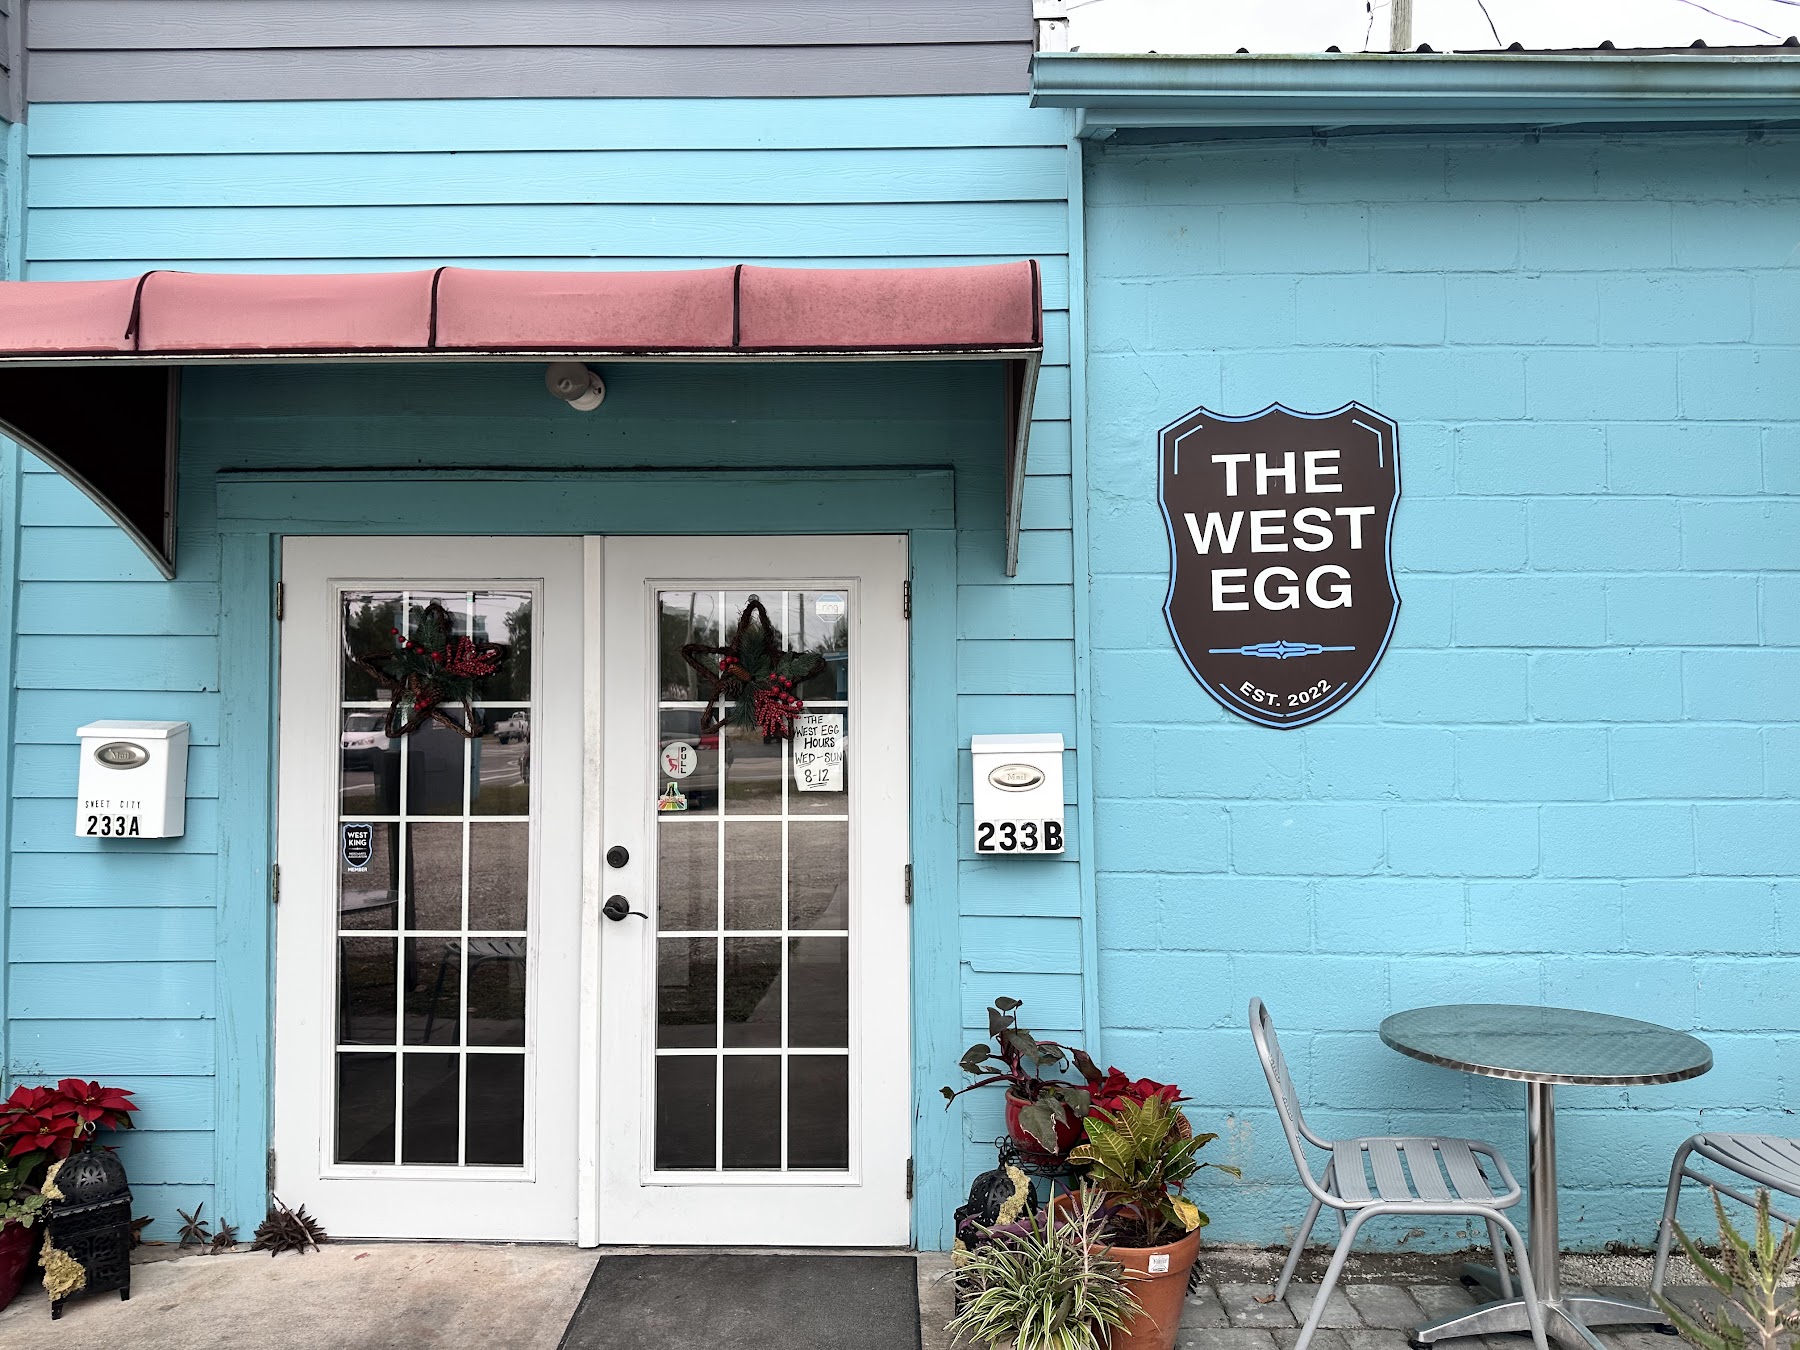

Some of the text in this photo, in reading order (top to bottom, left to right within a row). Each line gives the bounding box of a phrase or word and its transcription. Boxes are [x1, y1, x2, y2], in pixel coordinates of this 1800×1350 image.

[1211, 450, 1343, 496] THE
[1183, 506, 1376, 555] WEST
[1211, 564, 1353, 612] EGG
[1239, 679, 1332, 707] EST. 2022
[803, 715, 824, 724] THE
[794, 724, 840, 738] WEST EGG
[804, 737, 835, 749] HOURS
[111, 750, 130, 759] Mail
[804, 768, 830, 783] 8-12
[1007, 773, 1027, 781] Mail
[120, 800, 140, 809] CITY
[86, 815, 140, 836] 233A
[978, 821, 1063, 851] 233B
